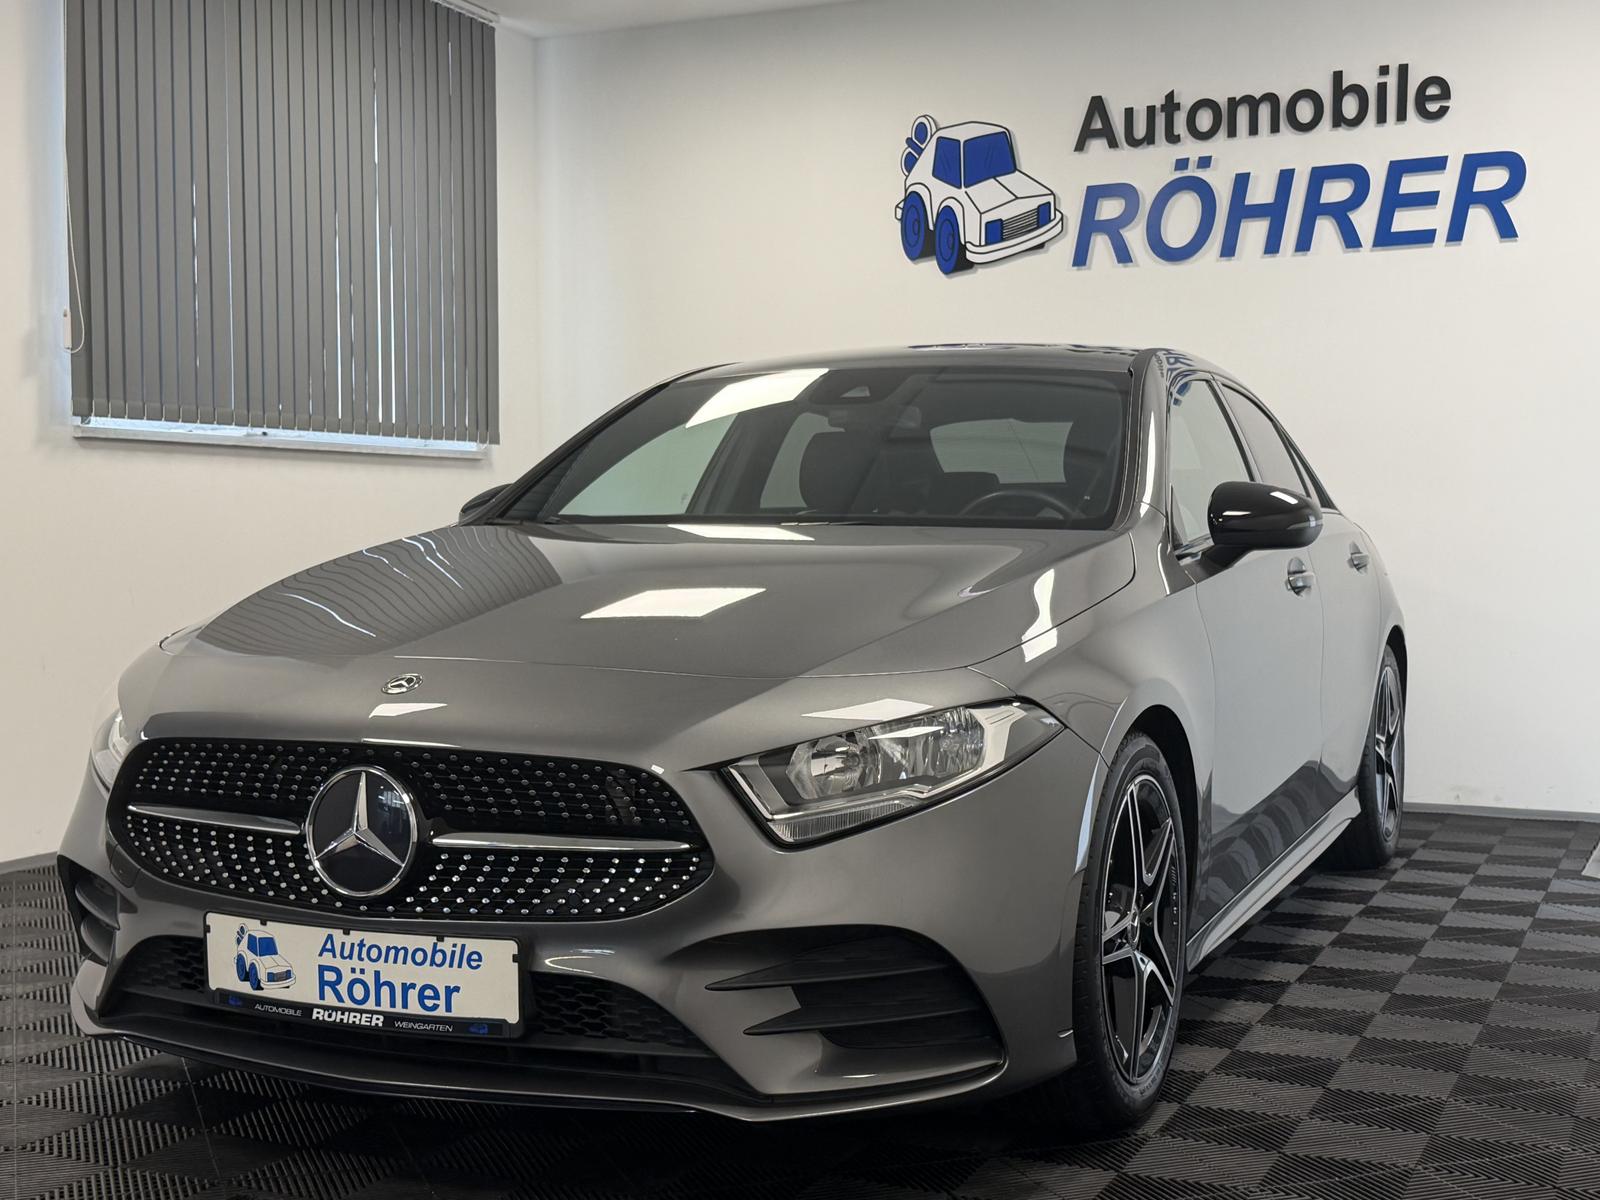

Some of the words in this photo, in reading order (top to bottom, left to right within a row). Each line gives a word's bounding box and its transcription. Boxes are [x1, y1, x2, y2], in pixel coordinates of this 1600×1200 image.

[1073, 64, 1452, 153] Automobile
[1072, 150, 1528, 268] RÖHRER
[318, 933, 483, 970] Automobile
[317, 964, 461, 1013] Röhrer
[254, 1003, 303, 1017] AUTOMOBILE
[311, 1008, 384, 1027] RÖHRER
[394, 1020, 453, 1033] WEINGARTEN
